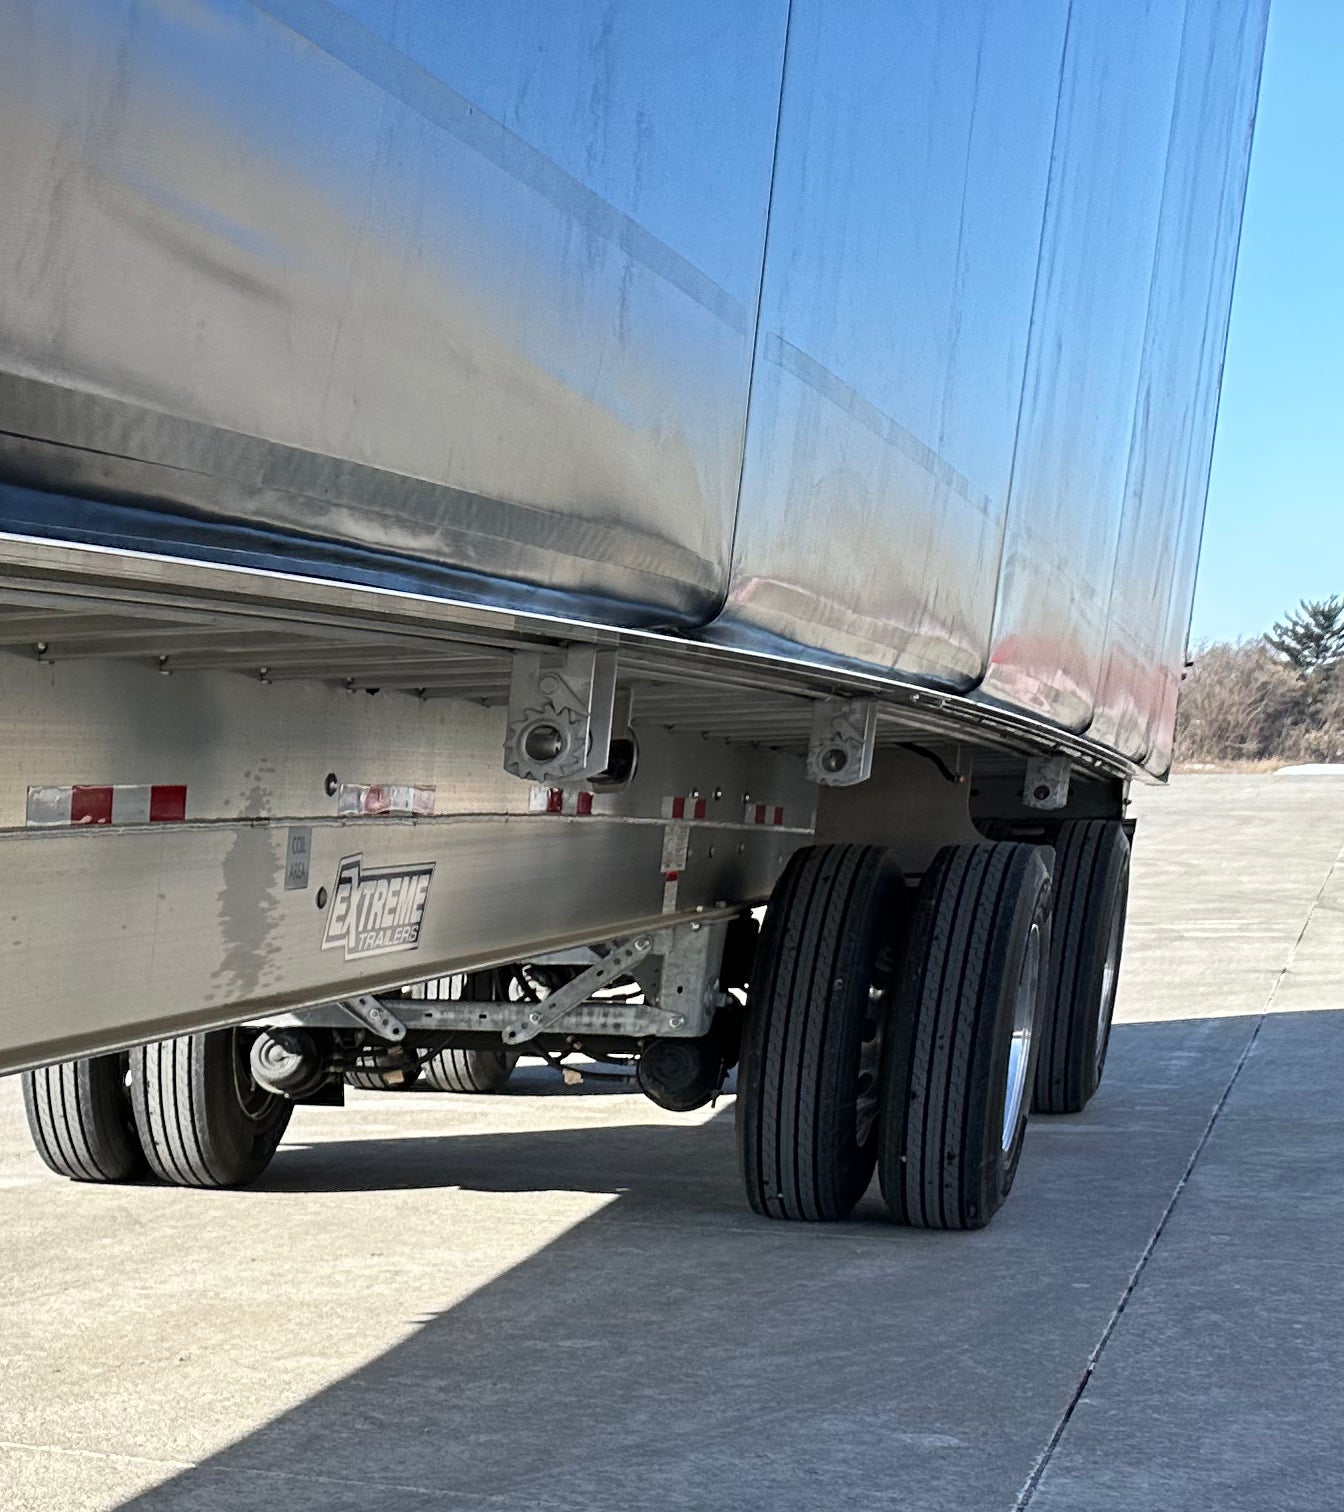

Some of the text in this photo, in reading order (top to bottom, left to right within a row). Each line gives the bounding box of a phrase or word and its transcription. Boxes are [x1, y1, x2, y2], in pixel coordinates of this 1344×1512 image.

[288, 862, 305, 880] AREA
[328, 867, 431, 948] EXTREME
[358, 924, 419, 952] TRAILERS
